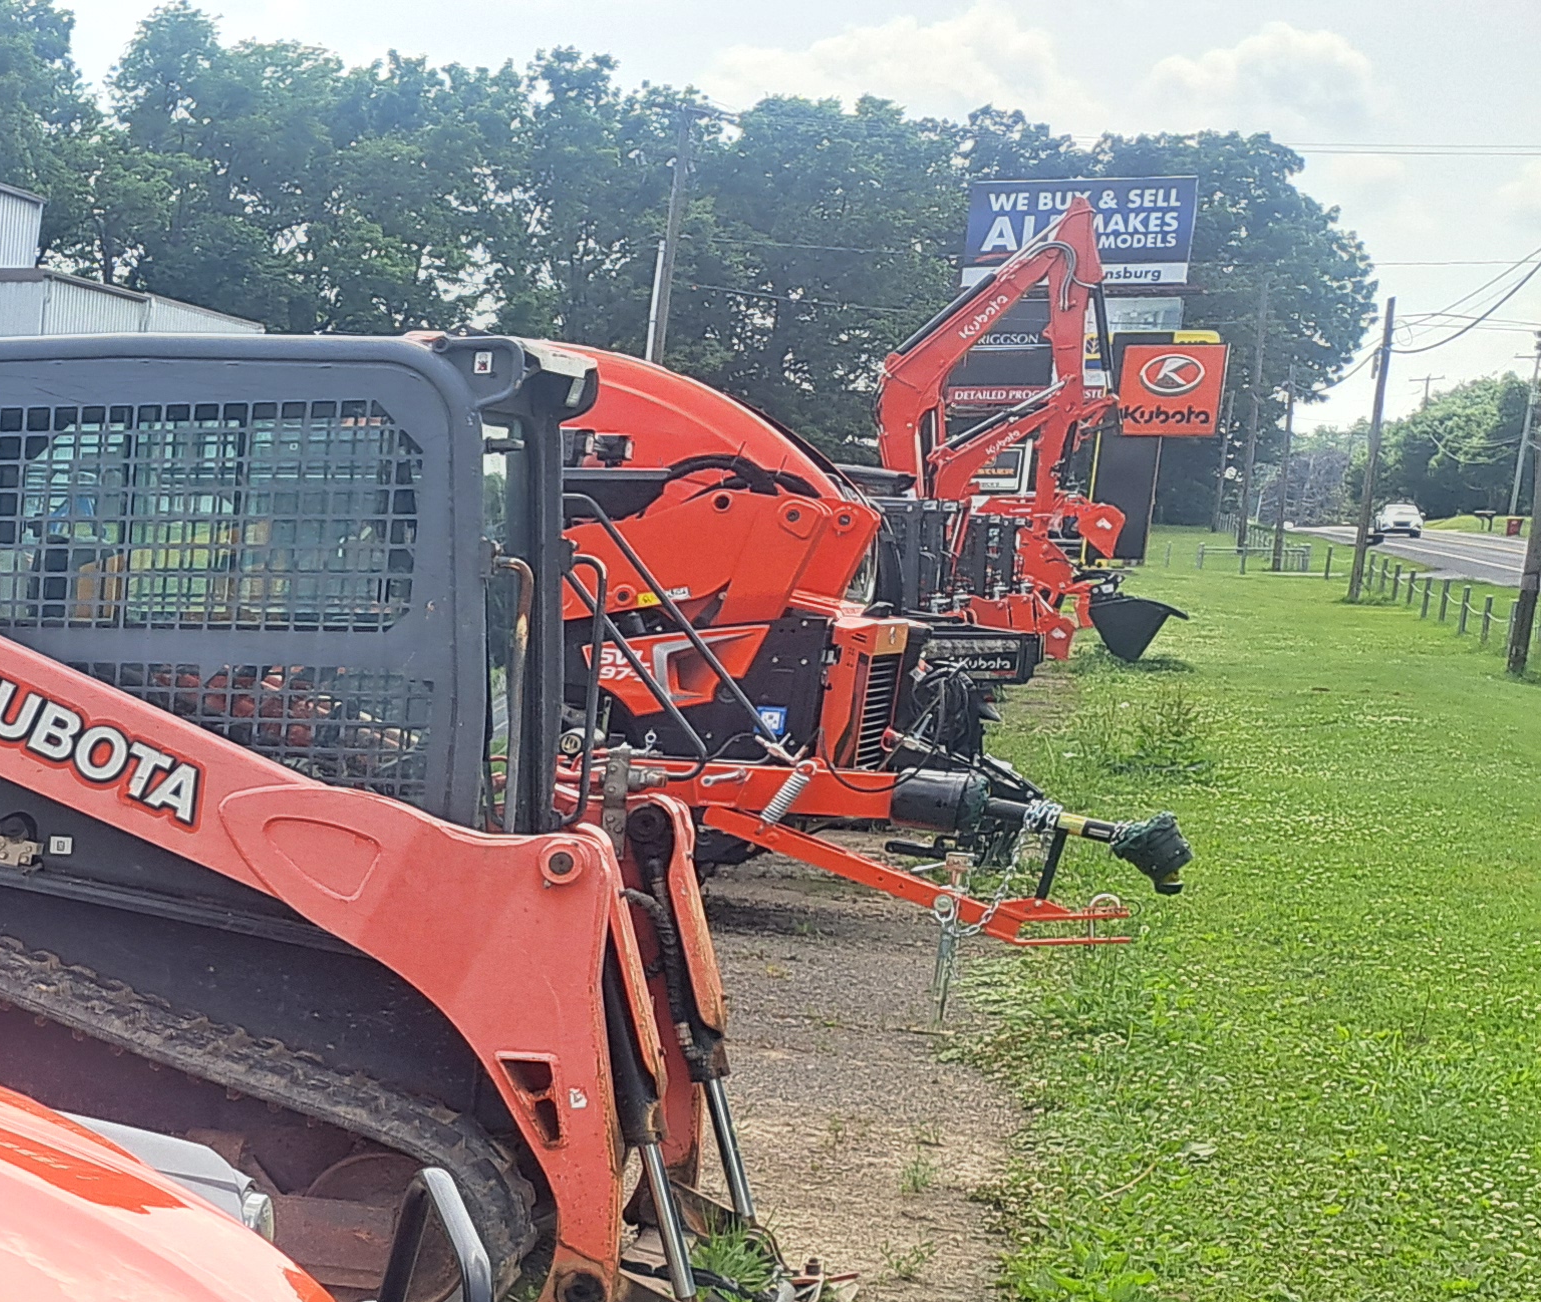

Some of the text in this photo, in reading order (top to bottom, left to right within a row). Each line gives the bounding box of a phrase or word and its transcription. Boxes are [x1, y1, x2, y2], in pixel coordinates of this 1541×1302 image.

[989, 192, 1029, 211] WE
[1098, 190, 1118, 209] &
[1127, 188, 1181, 208] SELL
[1098, 233, 1177, 249] MODELS
[958, 294, 1009, 340] Kubota
[954, 389, 1007, 400] DETAILED
[1121, 404, 1211, 425] Kubota
[984, 430, 1021, 455] Kubota
[958, 656, 1011, 669] Kubota
